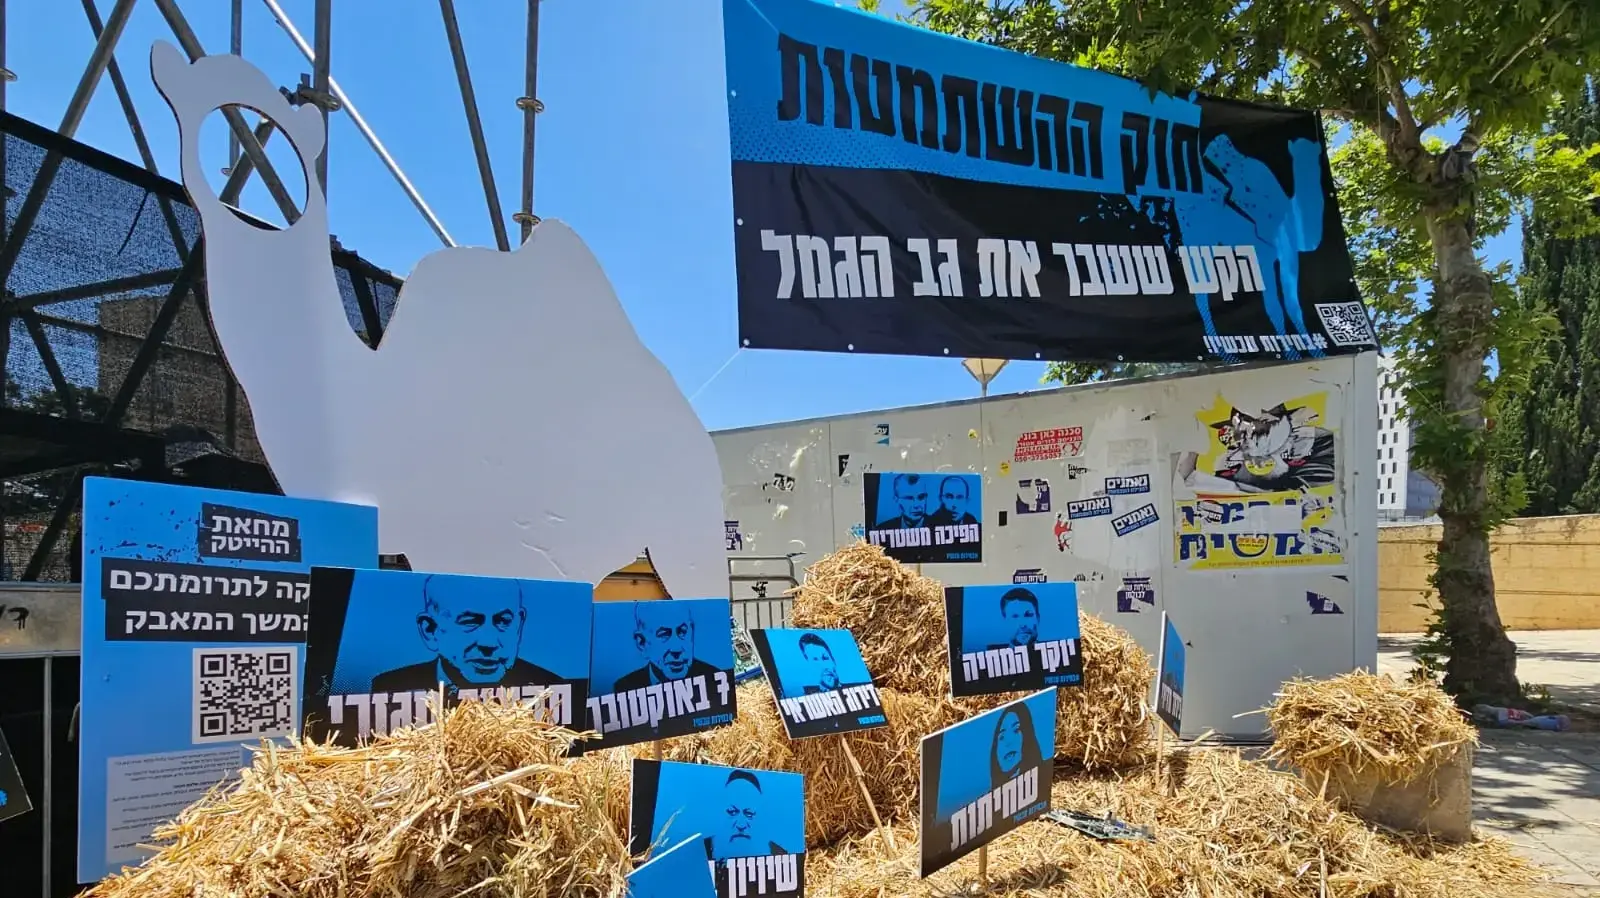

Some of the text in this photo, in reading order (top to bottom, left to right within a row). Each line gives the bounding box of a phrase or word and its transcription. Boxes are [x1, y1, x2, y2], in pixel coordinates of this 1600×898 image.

[777, 32, 1204, 195] חוק ההשתמטות
[761, 229, 1266, 301] הקש ששבר את גב הגמל
[1203, 333, 1328, 354] #בחירות עכשיו!
[1106, 475, 1148, 489] נאמנים
[1069, 498, 1110, 513] נאמנים
[1114, 504, 1155, 530] נאמנים
[211, 515, 290, 538] מחאת
[868, 523, 979, 548] הפיכה משטרית
[211, 535, 290, 554] ההייטק
[110, 568, 311, 603] קה לתרומתכם
[125, 610, 309, 635] משך המאבק
[962, 638, 1076, 682] יוקר המחיה
[586, 674, 711, 734] באוקטובר
[780, 683, 881, 724] דירוג האשראי
[950, 766, 1039, 851] שחיתות
